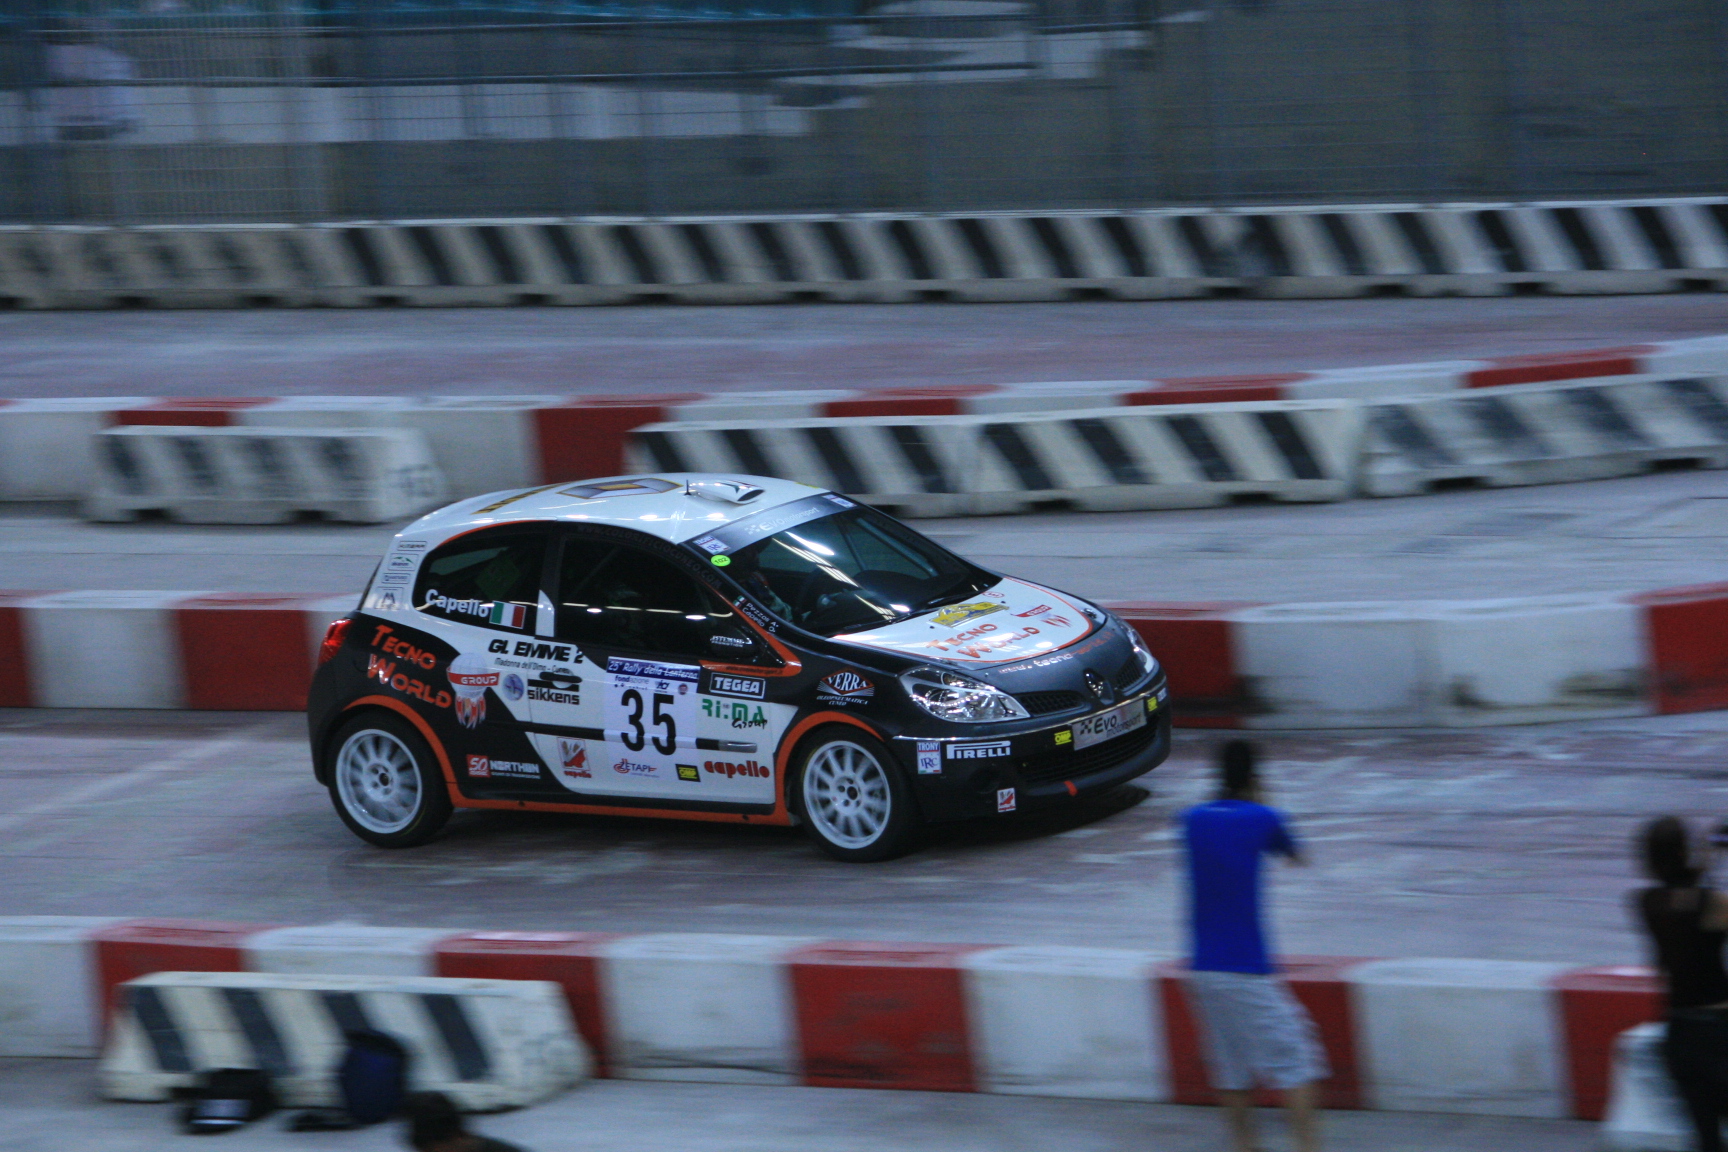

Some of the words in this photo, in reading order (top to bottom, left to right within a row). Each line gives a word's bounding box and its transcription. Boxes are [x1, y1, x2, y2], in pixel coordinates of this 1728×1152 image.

[425, 588, 489, 618] Capello
[742, 607, 765, 627] Capello
[371, 624, 437, 669] TECNO
[926, 623, 998, 651] TECNO
[494, 657, 520, 668] Madonna
[513, 641, 572, 663] EMME
[573, 650, 584, 665] 2
[367, 653, 453, 709] WORLD
[461, 675, 498, 685] GROUP
[614, 674, 651, 685] fondazione
[622, 662, 642, 676] Rally
[643, 665, 664, 676] della
[664, 669, 700, 681] Lanterna
[714, 676, 761, 694] TEGEA
[827, 672, 868, 691] VERRA
[527, 687, 581, 706] sikkens
[620, 688, 677, 756] 35
[731, 718, 768, 730] Group
[918, 741, 940, 751] TRONY
[946, 740, 1012, 760] PIRELLI
[468, 757, 488, 771] 50
[704, 760, 770, 779] capello
[920, 757, 938, 770] IRC
